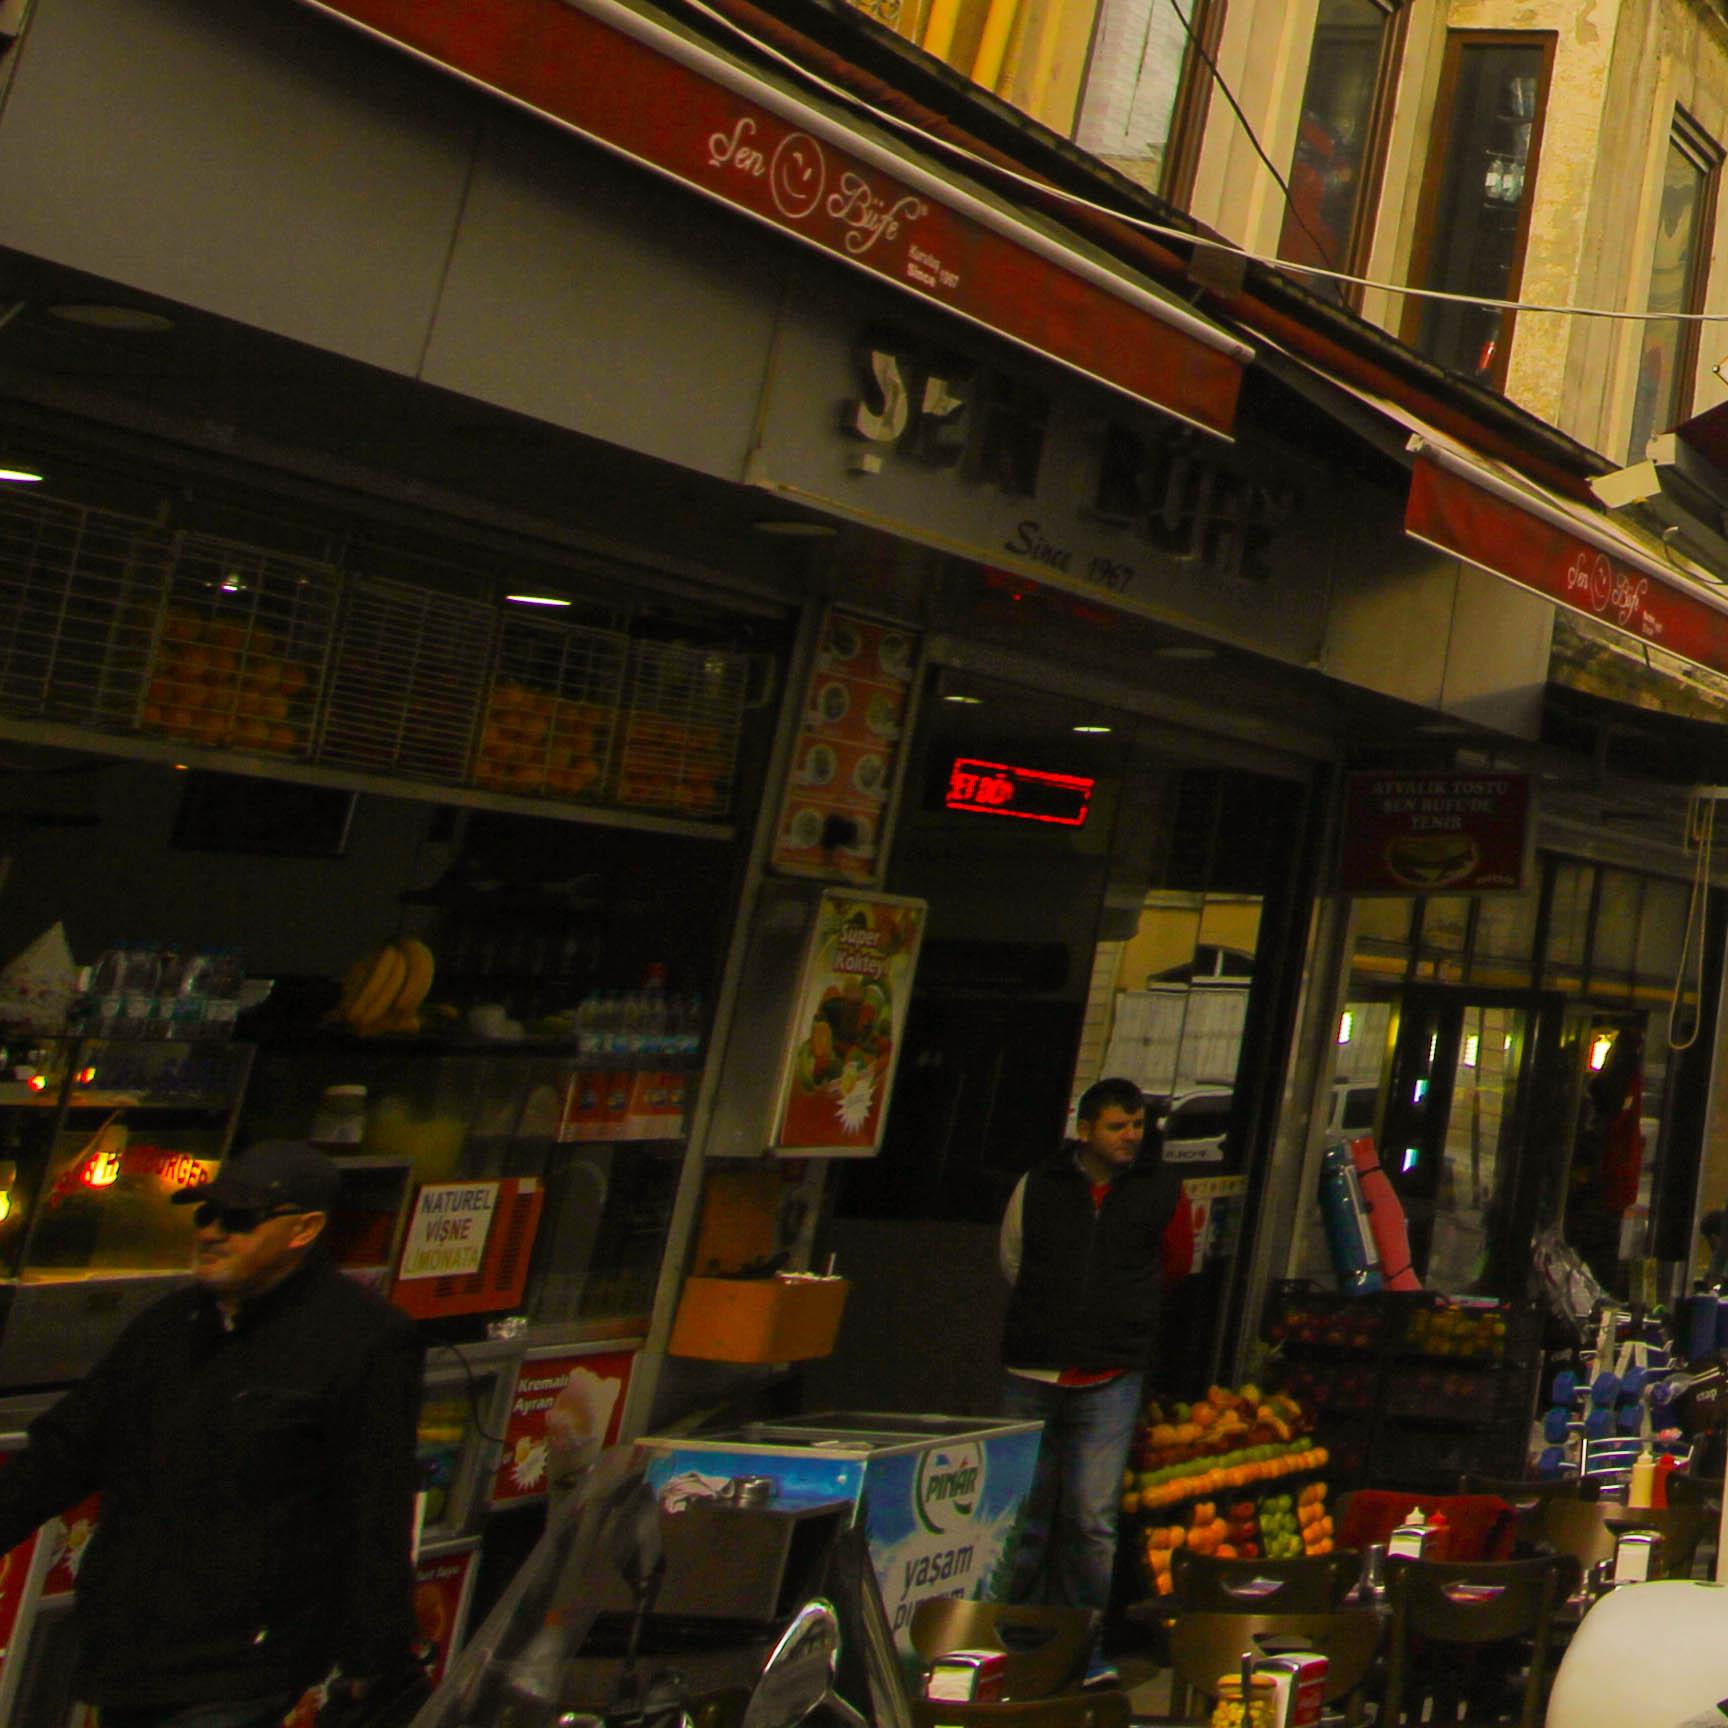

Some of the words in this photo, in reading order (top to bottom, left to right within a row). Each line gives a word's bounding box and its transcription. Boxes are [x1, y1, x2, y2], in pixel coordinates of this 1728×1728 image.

[839, 923, 881, 948] Super
[422, 1188, 492, 1214] NATUREL
[924, 1466, 979, 1503] PINAR
[899, 1543, 975, 1603] yaşam
